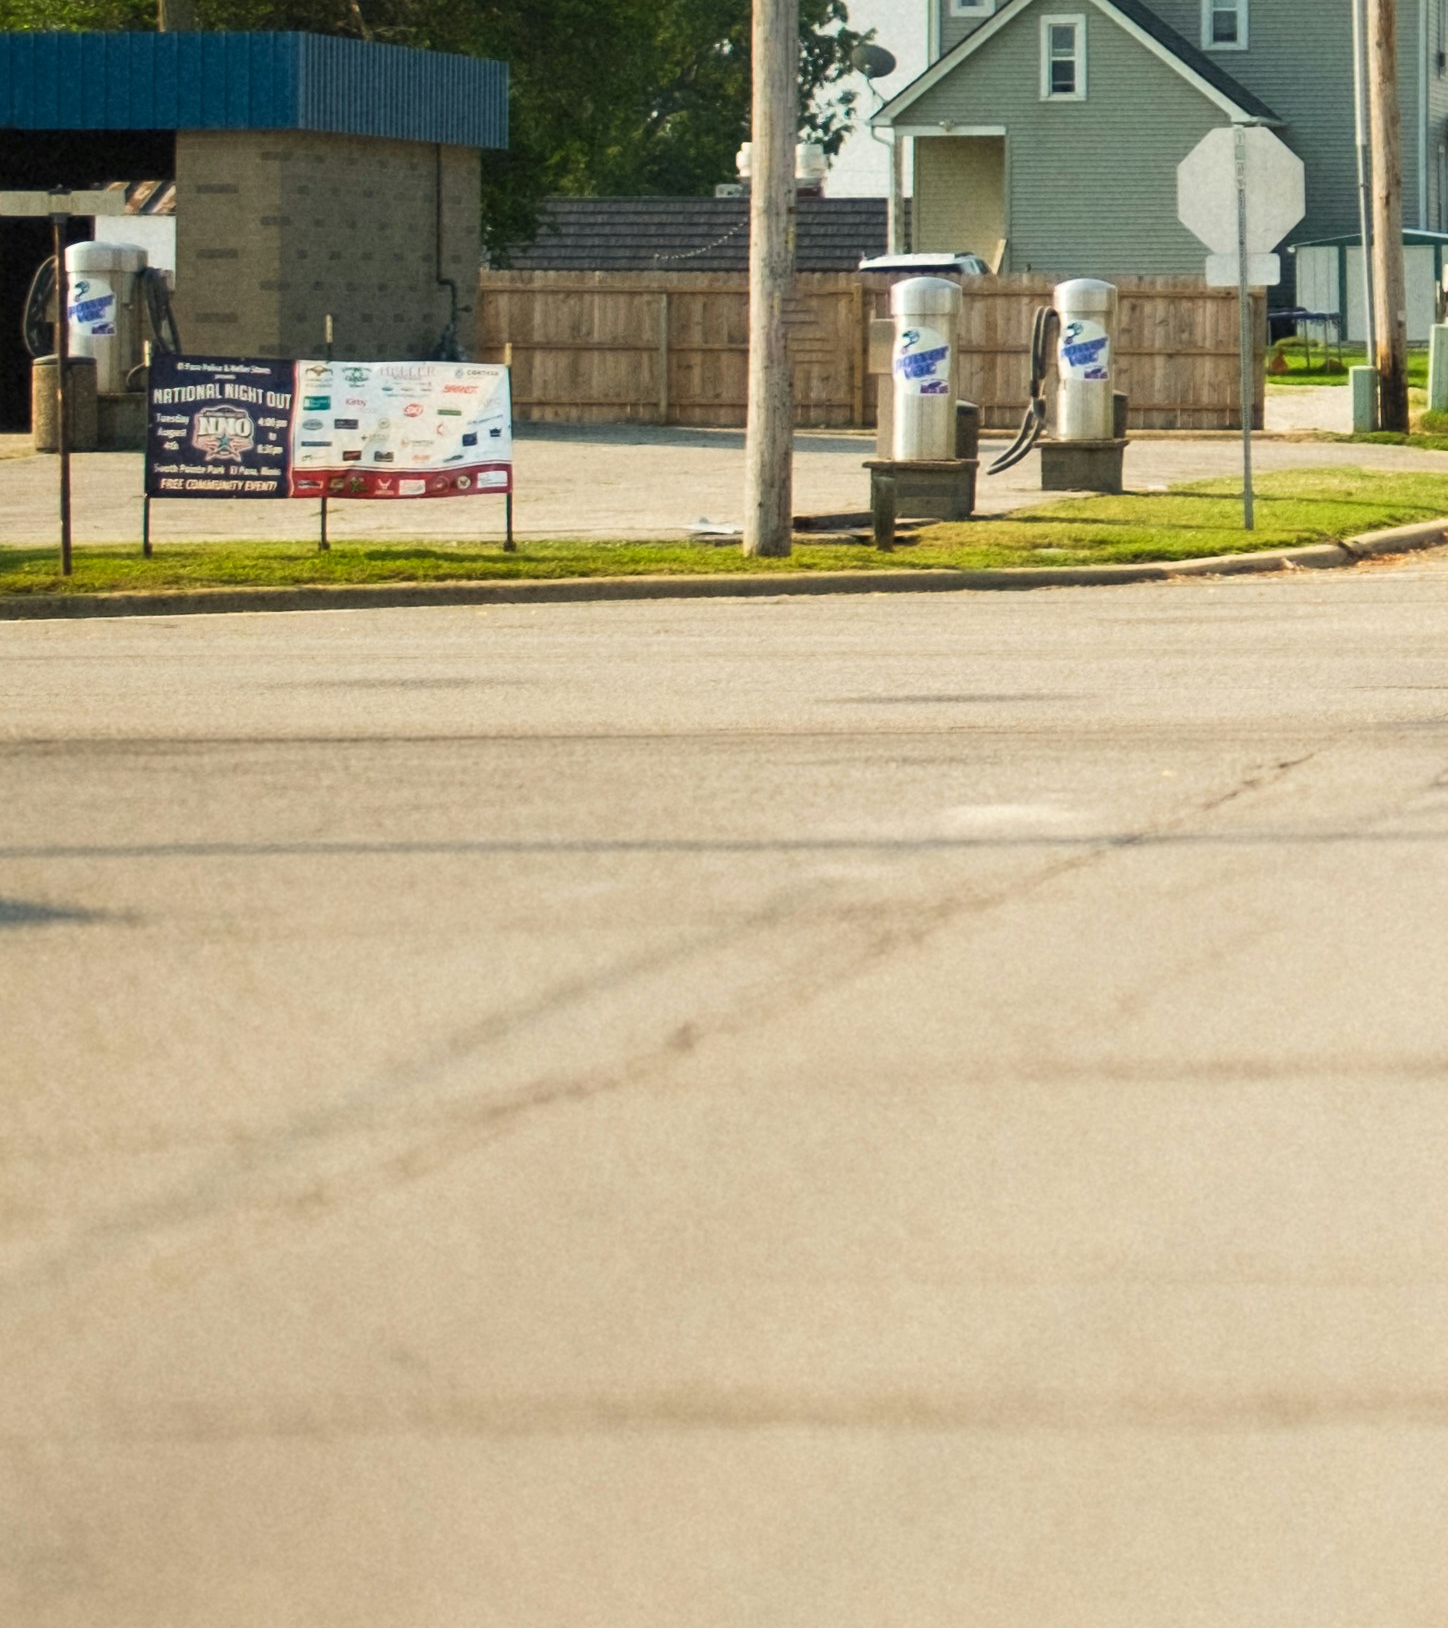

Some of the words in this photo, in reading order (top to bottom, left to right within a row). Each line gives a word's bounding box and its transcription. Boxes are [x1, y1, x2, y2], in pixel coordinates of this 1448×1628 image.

[154, 384, 221, 403] NATIONAL
[225, 384, 263, 403] NIGHT
[267, 391, 291, 409] OUT
[198, 417, 251, 436] NNO
[161, 478, 184, 489] FREE
[186, 479, 243, 490] COMMUNITY
